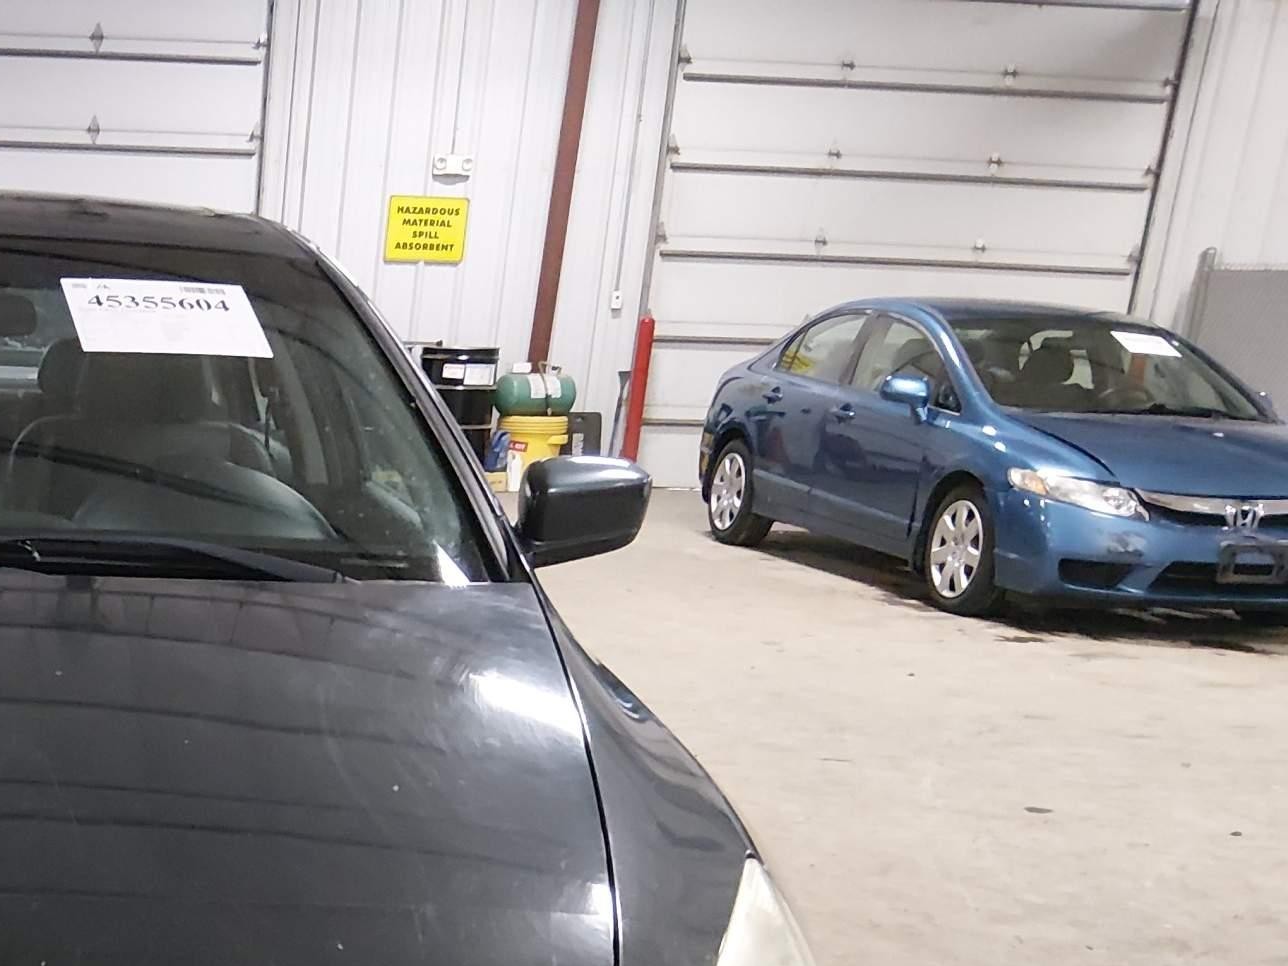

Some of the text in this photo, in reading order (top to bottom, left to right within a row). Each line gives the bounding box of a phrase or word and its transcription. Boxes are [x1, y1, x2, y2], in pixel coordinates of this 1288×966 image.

[397, 206, 460, 216] HAZARDOUS
[401, 218, 452, 228] MATERIAL
[412, 230, 439, 239] SPILL
[395, 242, 455, 252] ABSORBENT
[87, 294, 230, 312] 45355604
